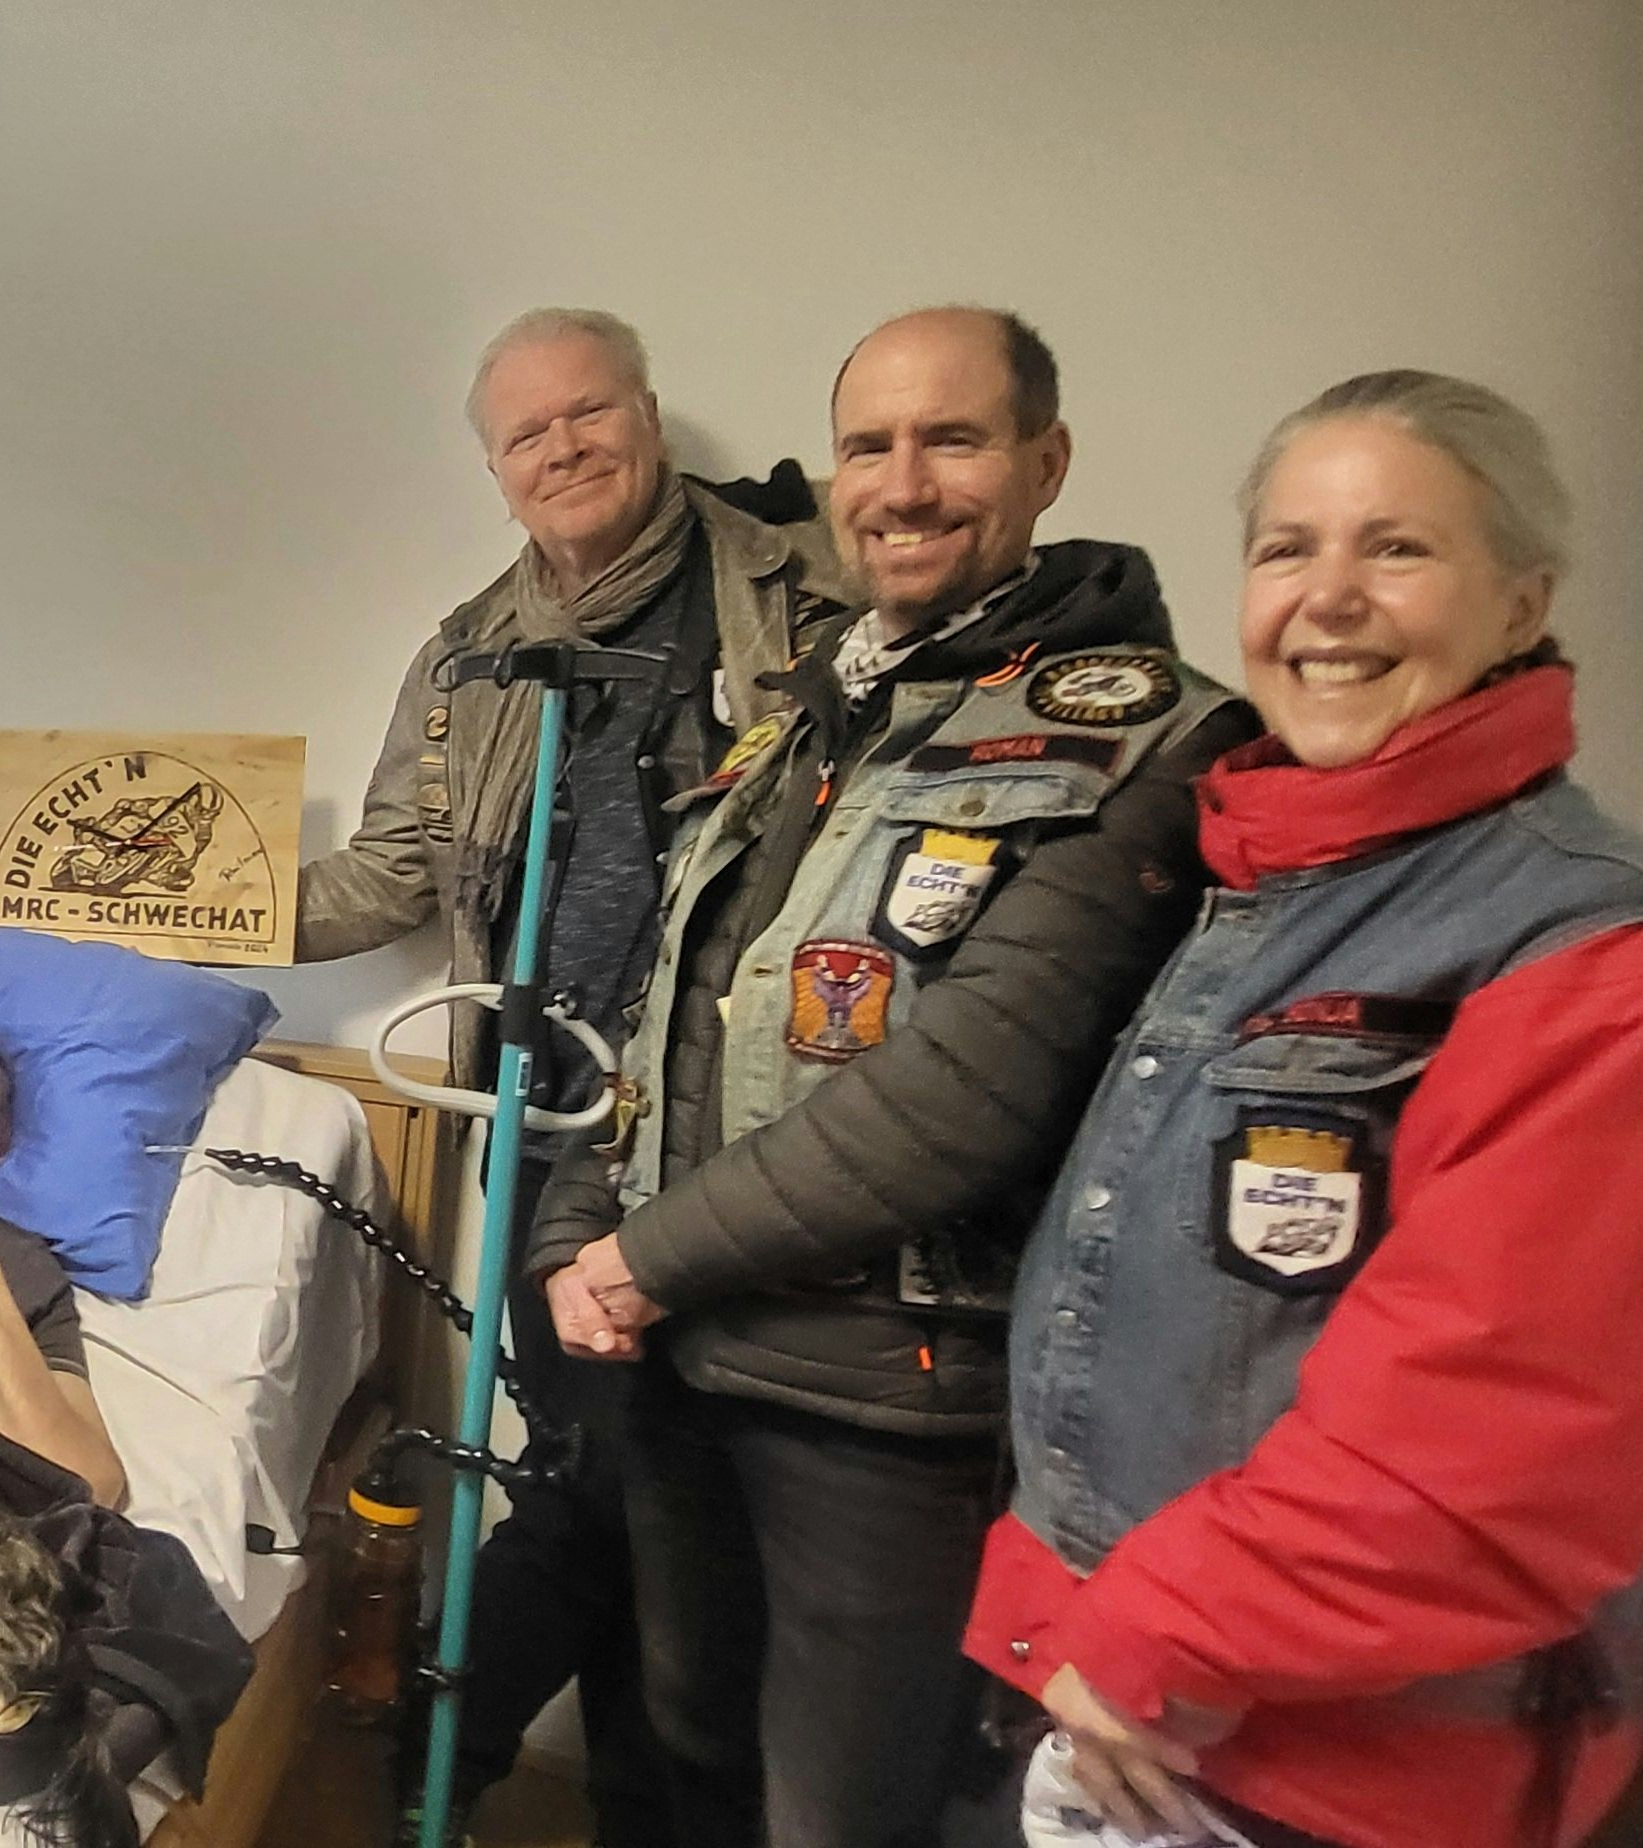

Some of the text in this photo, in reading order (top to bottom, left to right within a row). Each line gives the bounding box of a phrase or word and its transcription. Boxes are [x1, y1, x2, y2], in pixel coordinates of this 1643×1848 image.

[4, 835, 44, 889] DIE
[930, 863, 965, 879] DIE
[1, 896, 61, 921] MRC
[86, 900, 267, 933] SCHWECHAT
